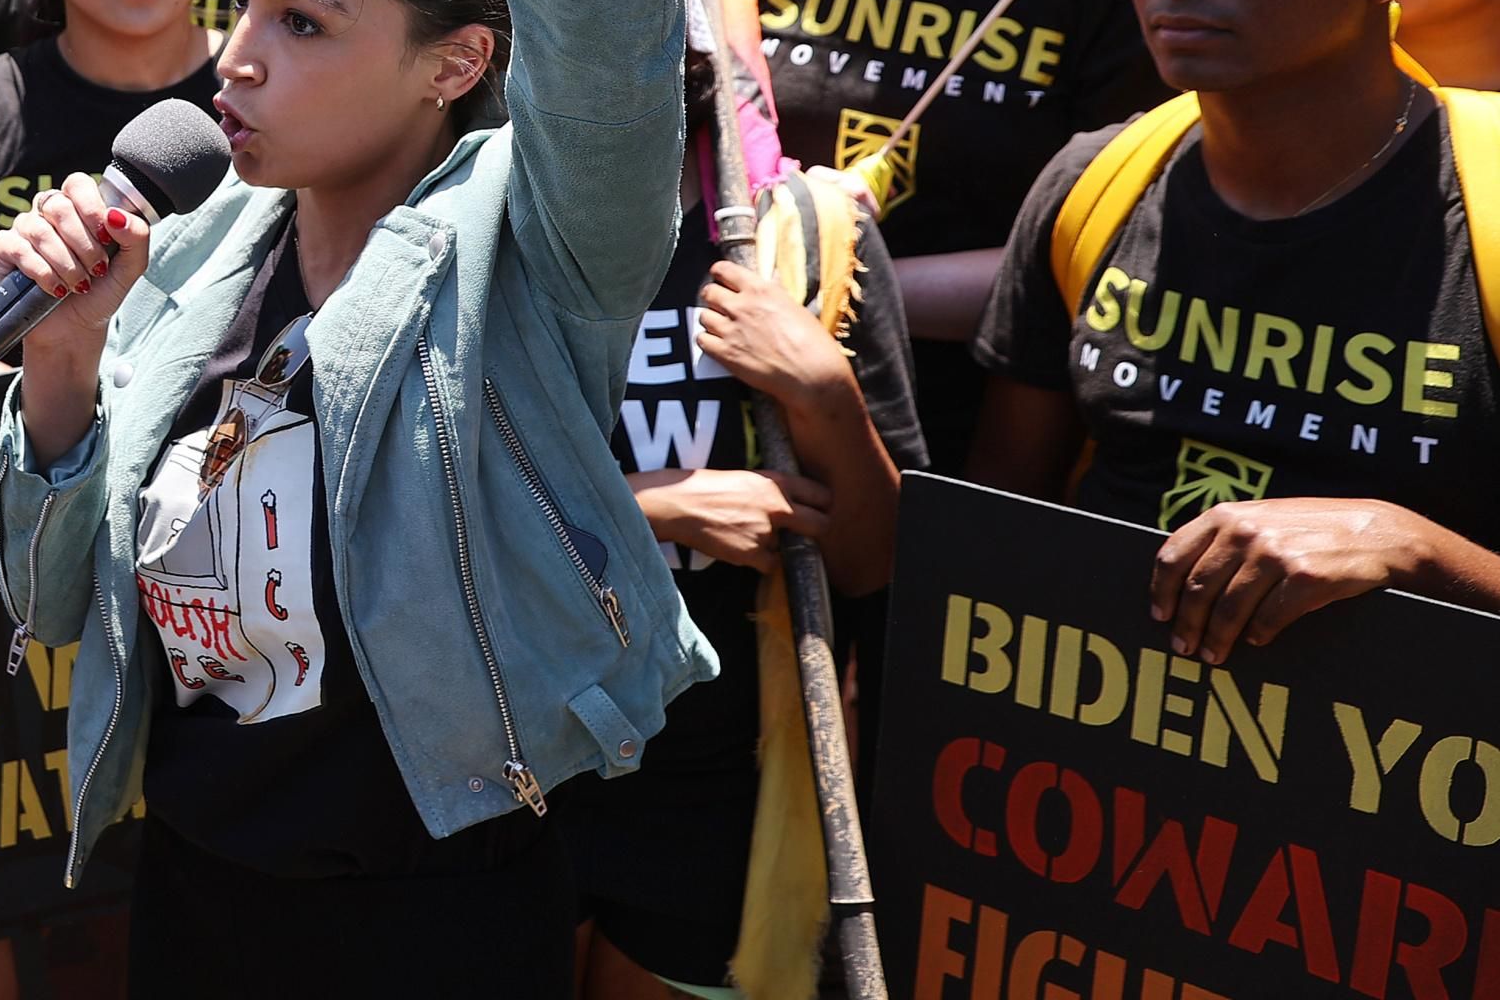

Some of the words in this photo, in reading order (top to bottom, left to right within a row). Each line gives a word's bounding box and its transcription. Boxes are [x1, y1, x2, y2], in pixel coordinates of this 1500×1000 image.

[1078, 341, 1441, 465] MOVEMENT
[1084, 265, 1462, 419] SUNRISE
[940, 593, 1290, 785] BIDEN
[931, 736, 1500, 1000] COWAR
